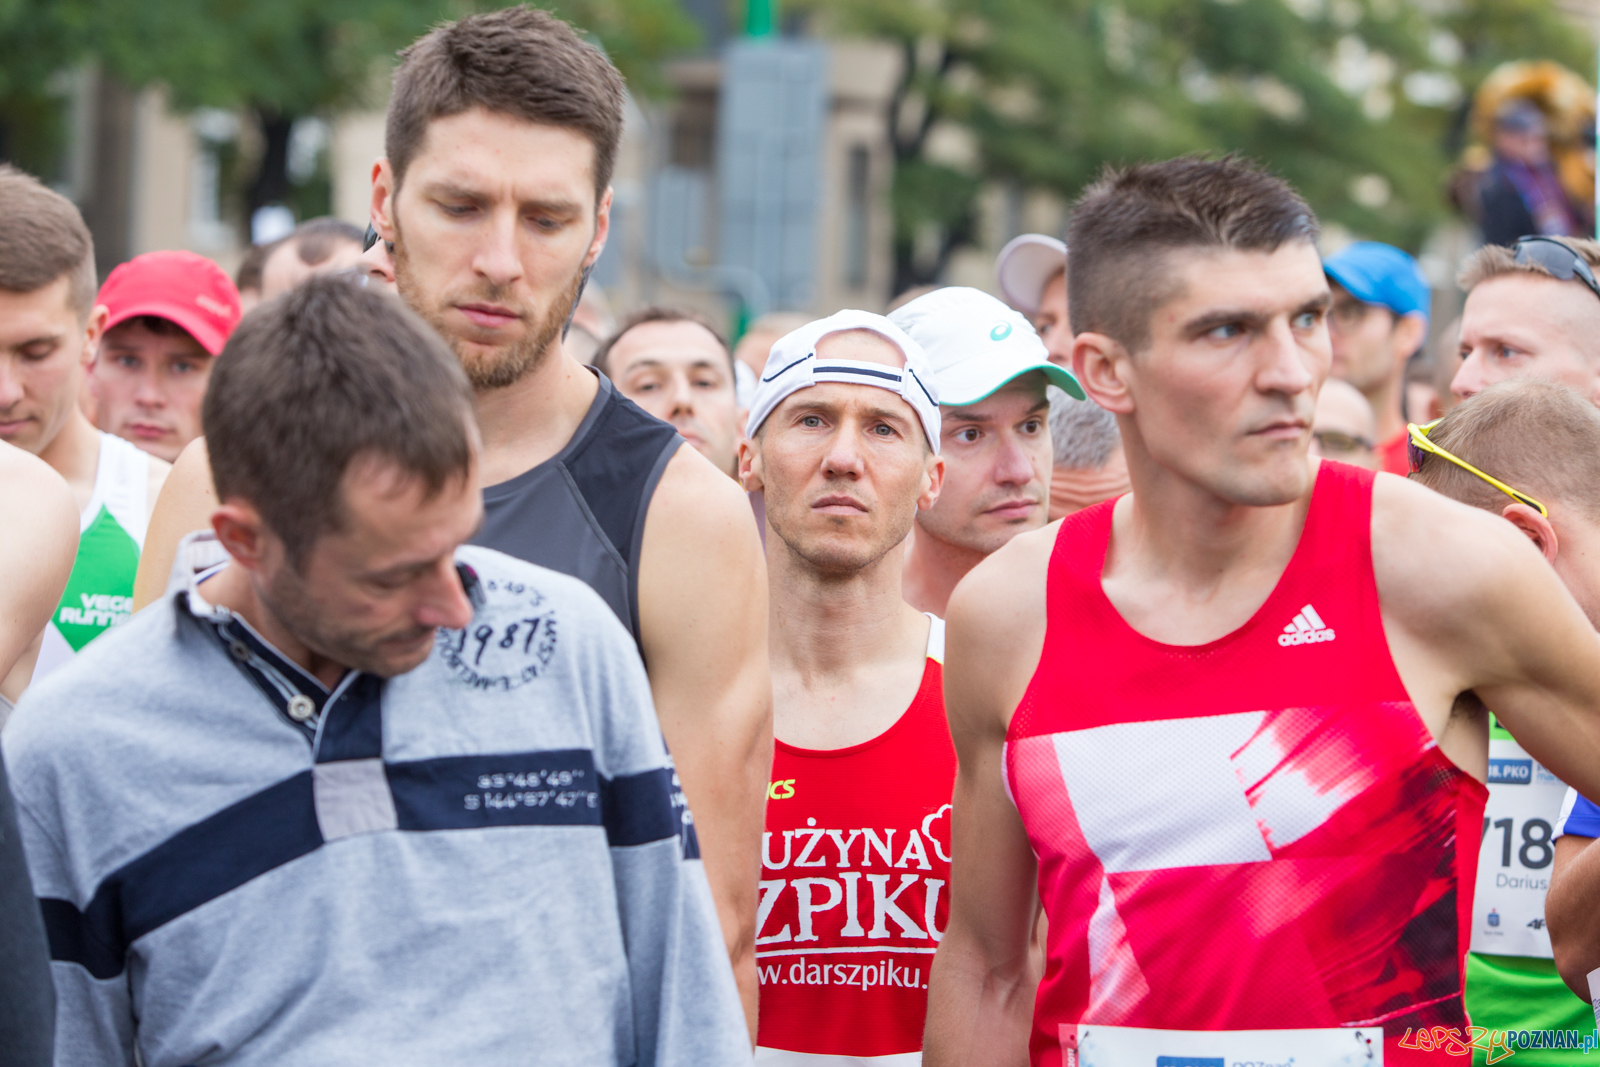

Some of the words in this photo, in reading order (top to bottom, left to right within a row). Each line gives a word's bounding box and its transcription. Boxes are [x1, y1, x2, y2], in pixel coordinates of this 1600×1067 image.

[455, 617, 541, 667] 1987
[1277, 628, 1336, 647] adidas
[1503, 764, 1529, 779] PKO
[759, 816, 932, 870] UŻYNA
[1496, 873, 1548, 889] Darius
